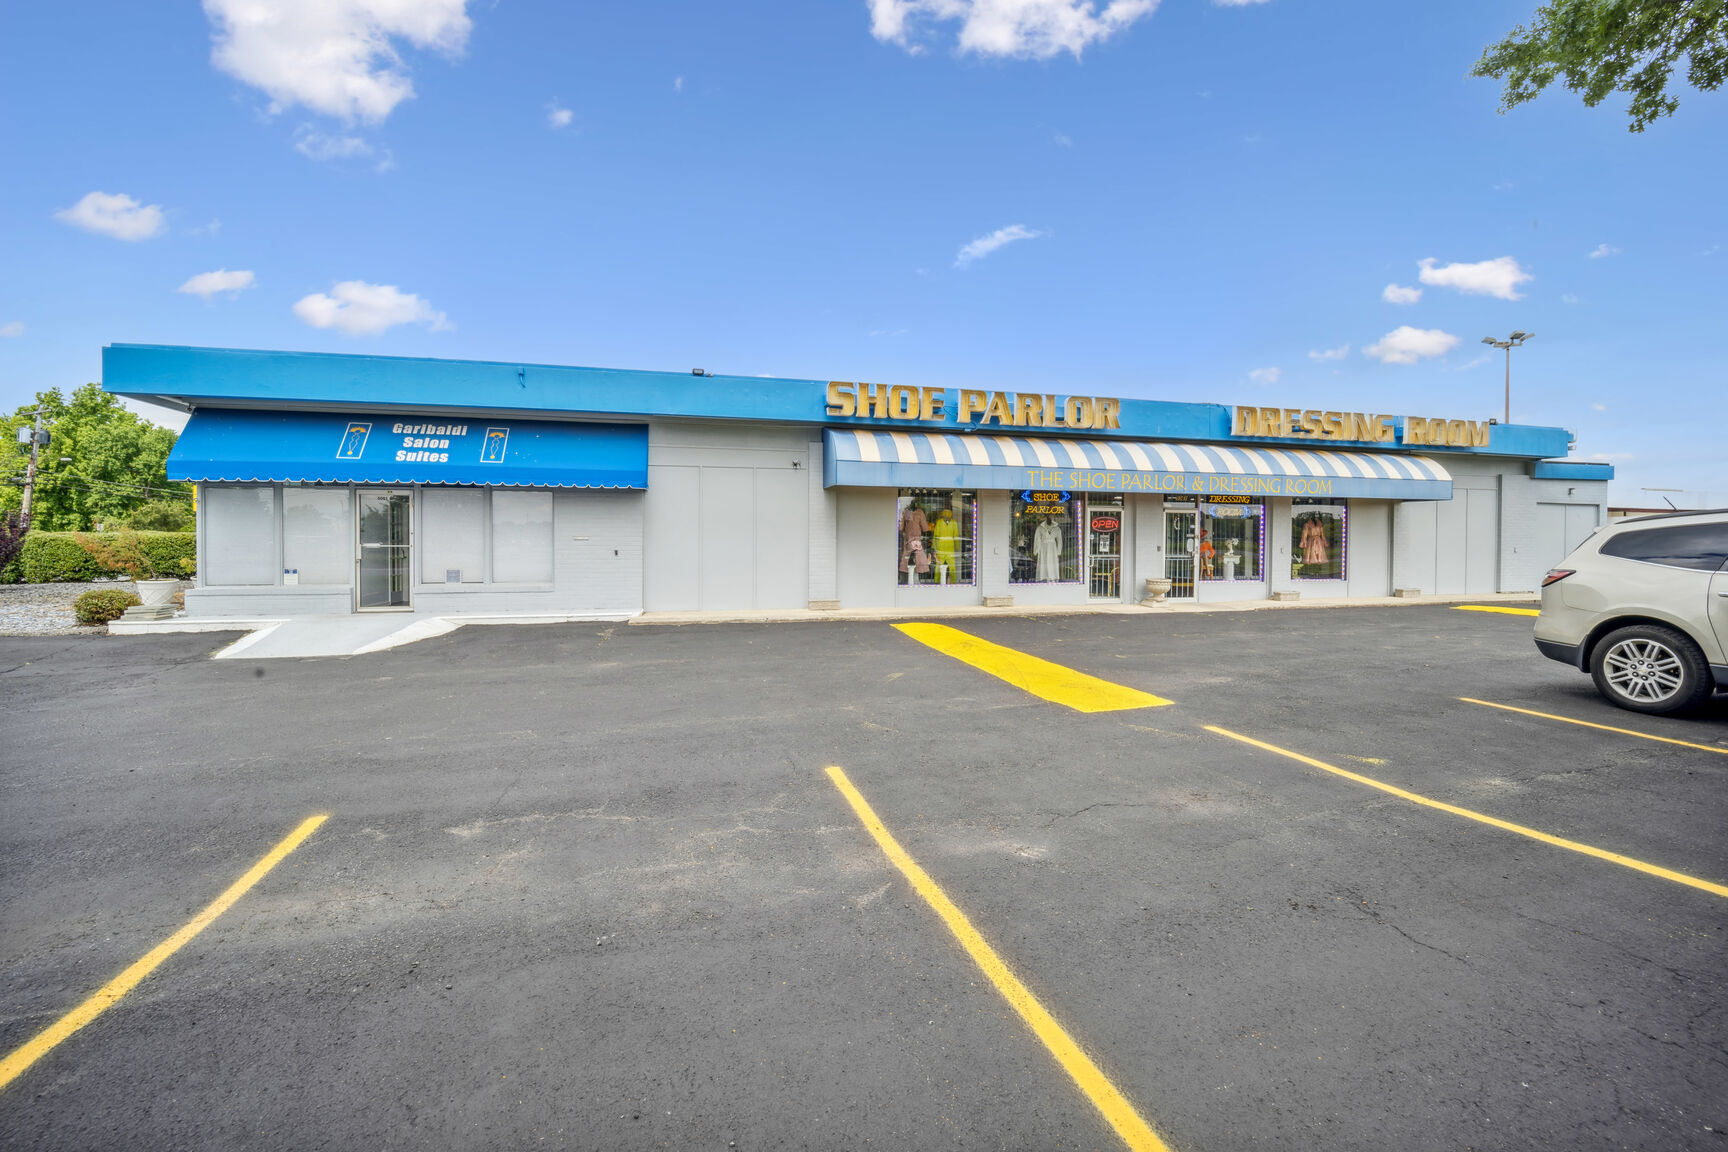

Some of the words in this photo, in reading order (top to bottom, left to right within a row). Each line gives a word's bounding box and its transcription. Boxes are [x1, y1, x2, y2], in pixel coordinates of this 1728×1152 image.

[826, 381, 946, 421] SHOE
[957, 389, 1121, 430] PARLOR
[392, 423, 468, 436] Garibaldi
[1231, 405, 1395, 443] DRESSING
[1402, 416, 1490, 448] ROOM
[403, 436, 450, 449] Salon
[395, 450, 449, 463] Suites
[1027, 470, 1064, 488] THE
[1070, 471, 1116, 489] SHOE
[1121, 473, 1187, 491] PARLOR
[1191, 475, 1205, 492] &
[1209, 476, 1281, 493] DRESSING
[1286, 478, 1332, 495] ROOM
[1033, 493, 1060, 502] SHOE
[1208, 495, 1251, 504] DRESSING
[1024, 505, 1065, 514] PARLOR
[1091, 520, 1119, 529] OPEN
